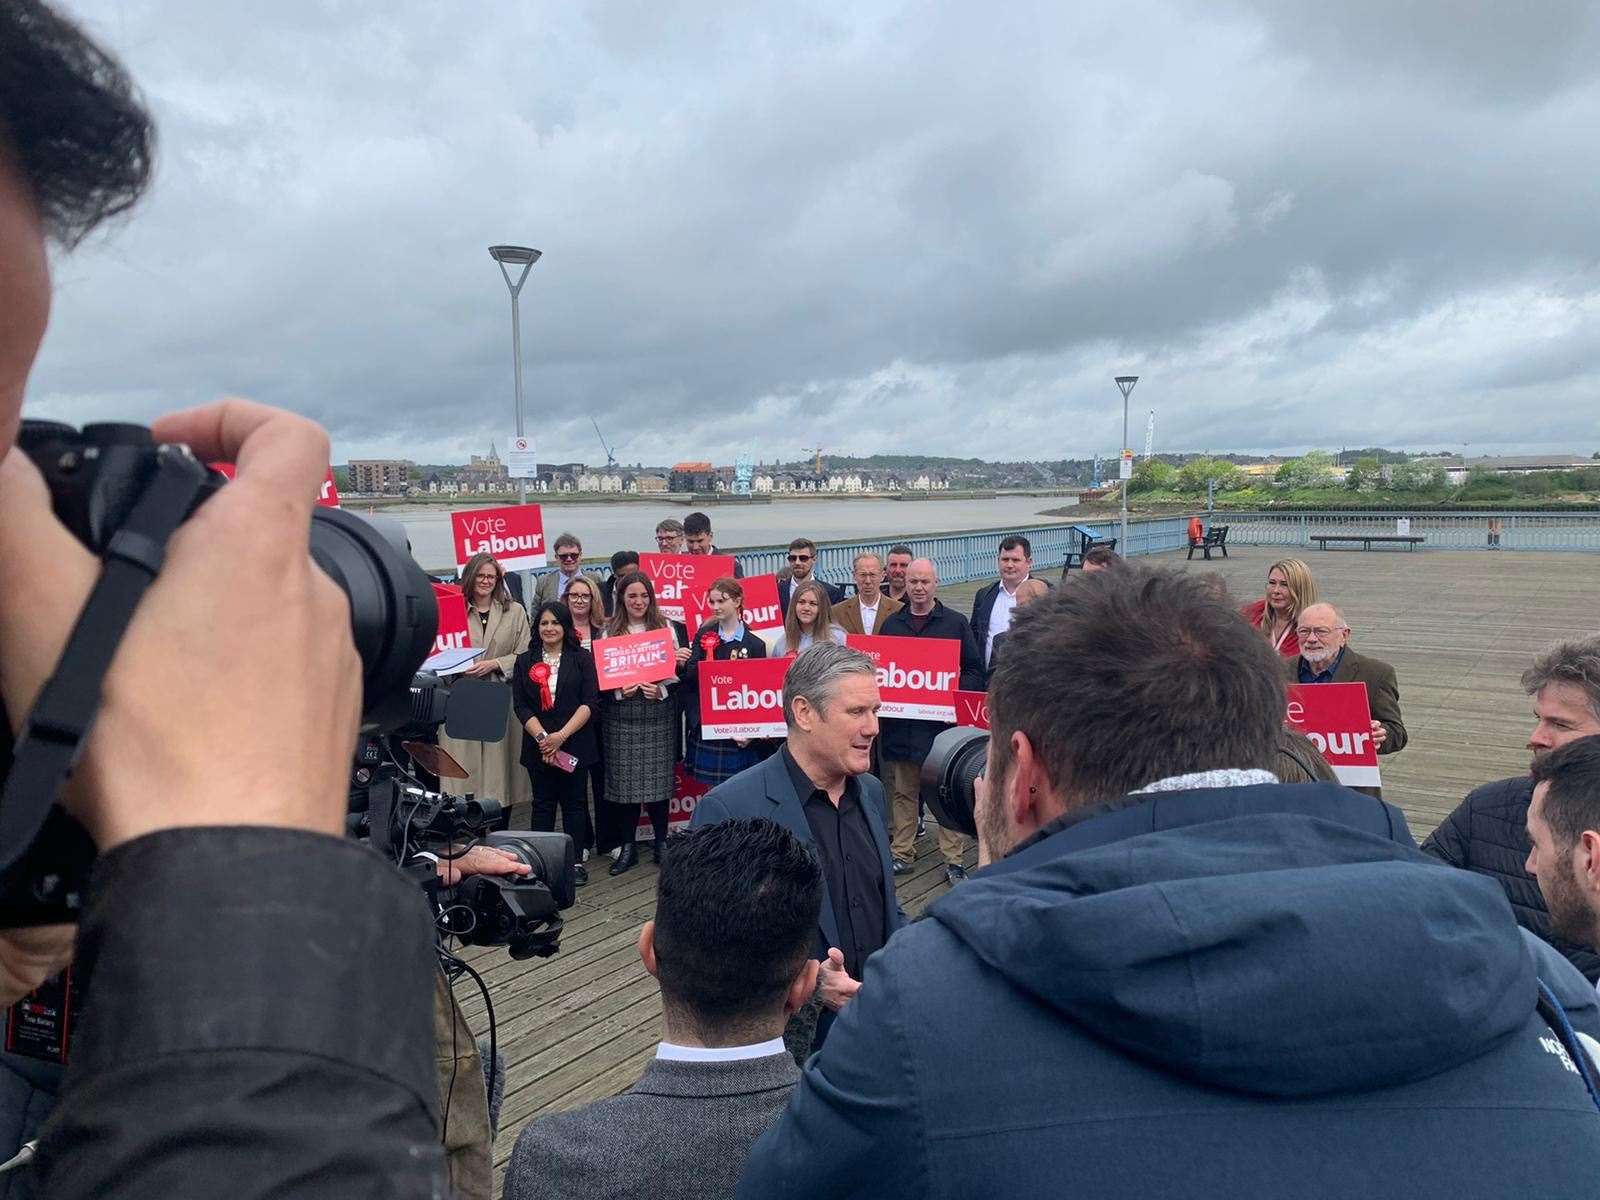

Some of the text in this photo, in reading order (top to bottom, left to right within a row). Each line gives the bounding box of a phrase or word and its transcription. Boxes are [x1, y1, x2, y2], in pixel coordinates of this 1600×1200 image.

[462, 517, 507, 536] Vote
[464, 533, 542, 556] Labour
[650, 559, 695, 580] Vote
[610, 650, 661, 668] BRITAIN
[711, 675, 733, 685] Vote
[876, 662, 956, 691] abour
[1305, 732, 1370, 755] our
